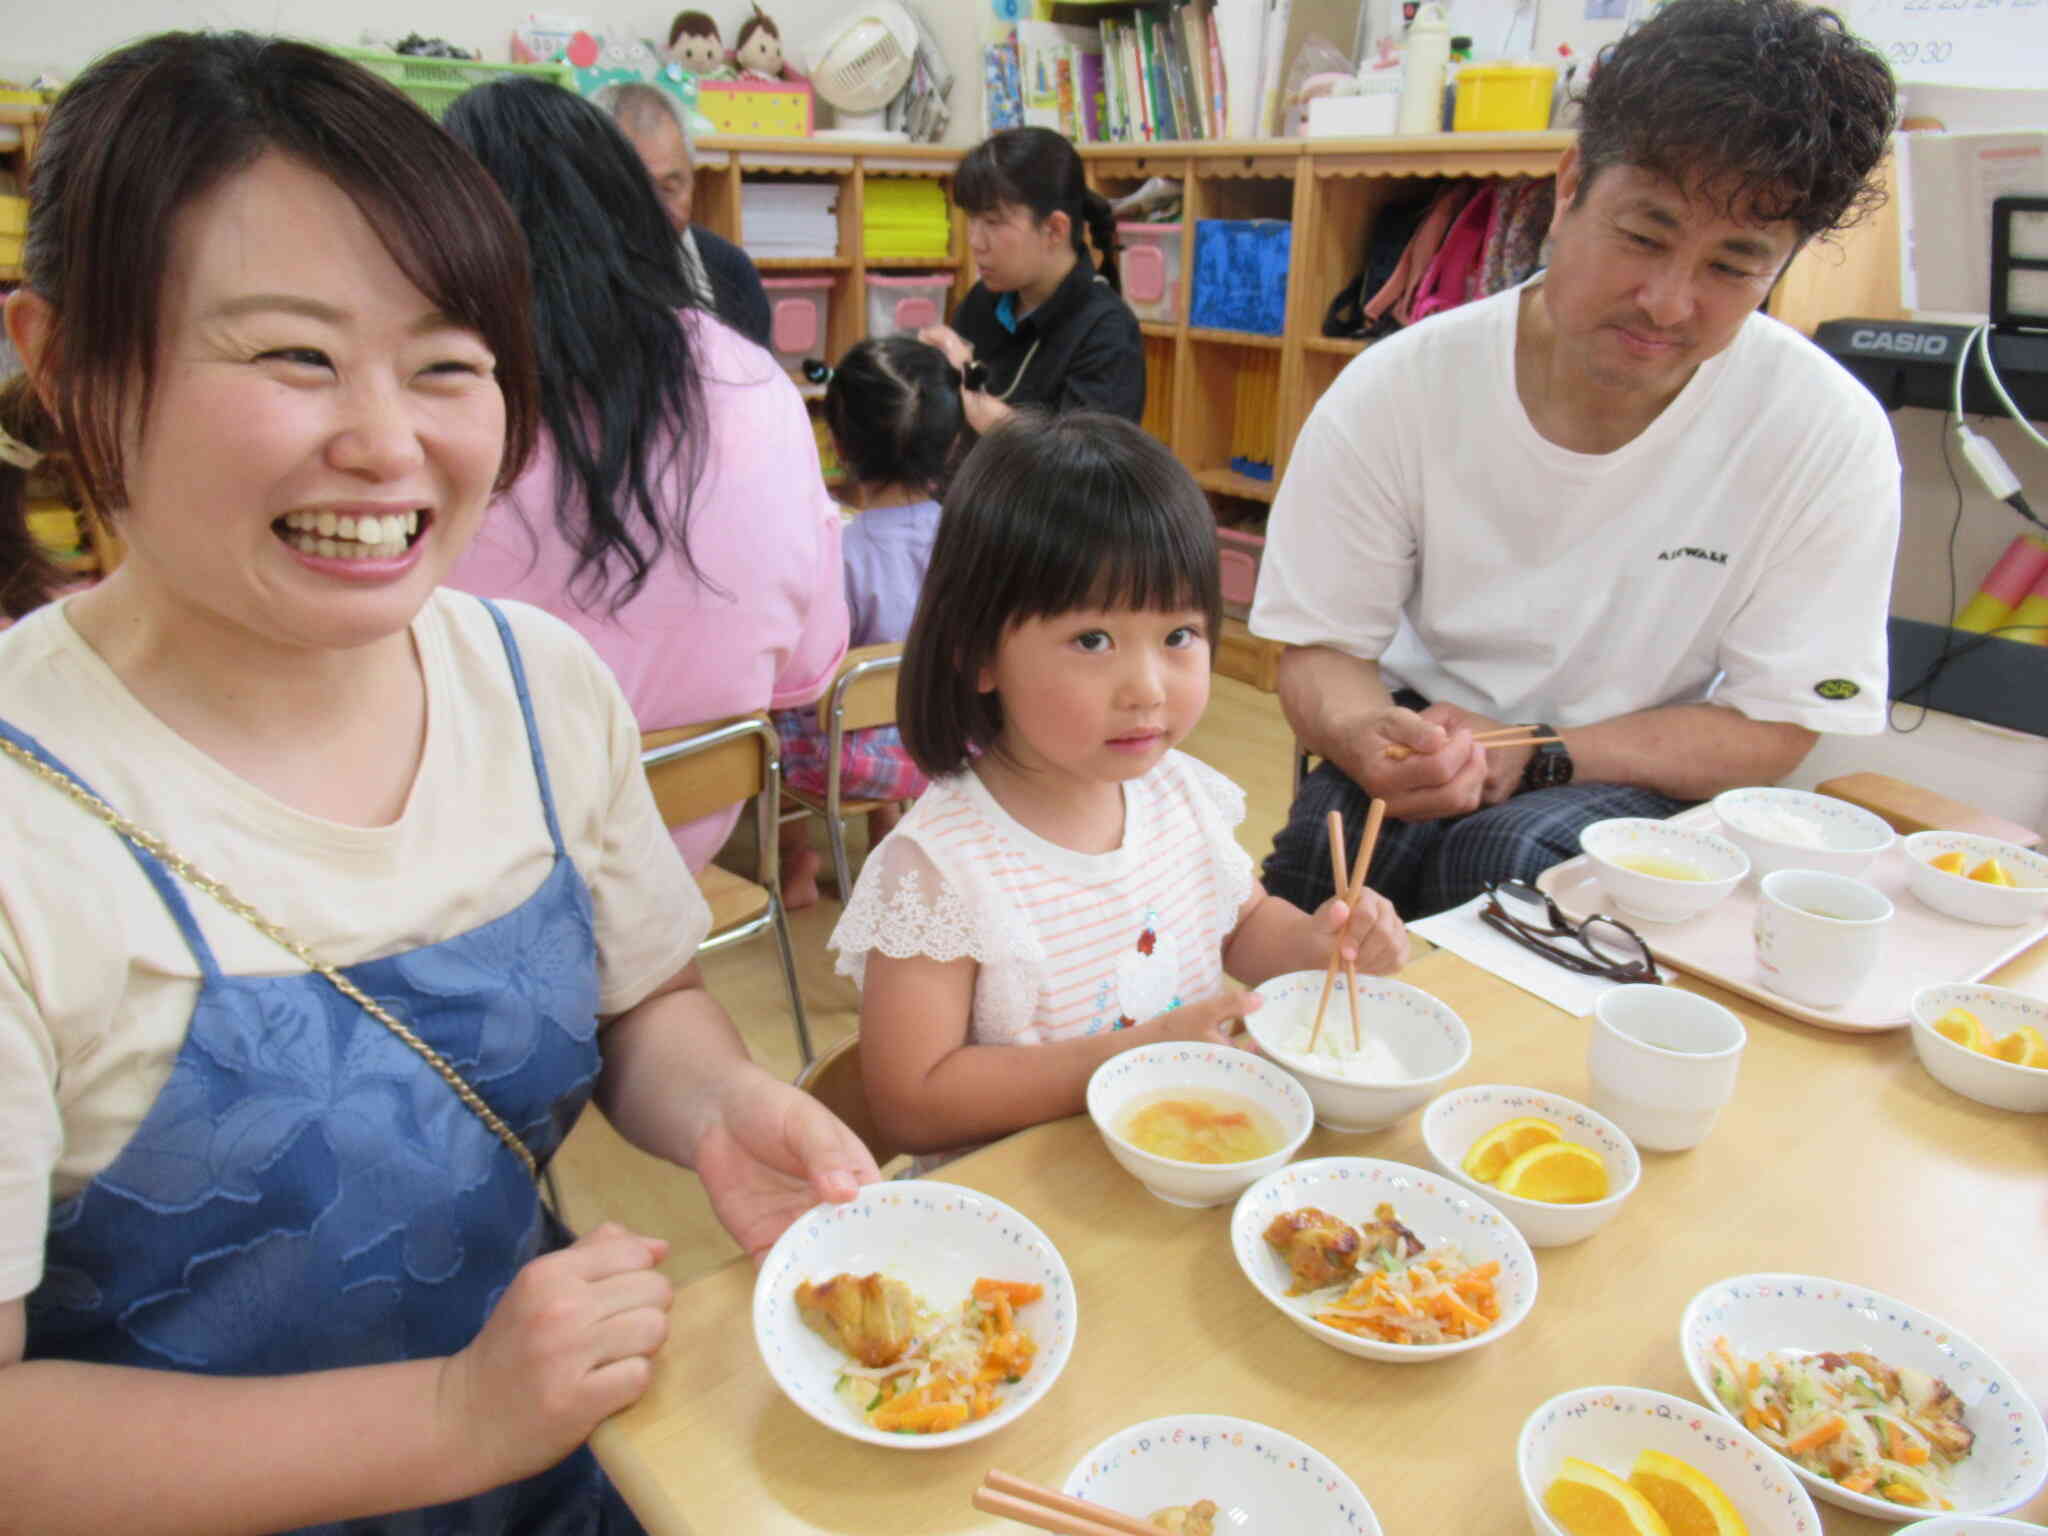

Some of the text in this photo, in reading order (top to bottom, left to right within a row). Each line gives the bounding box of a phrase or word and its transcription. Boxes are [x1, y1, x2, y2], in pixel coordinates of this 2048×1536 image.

[1887, 40, 1953, 64] 29 30
[1851, 330, 1948, 355] CASIO
